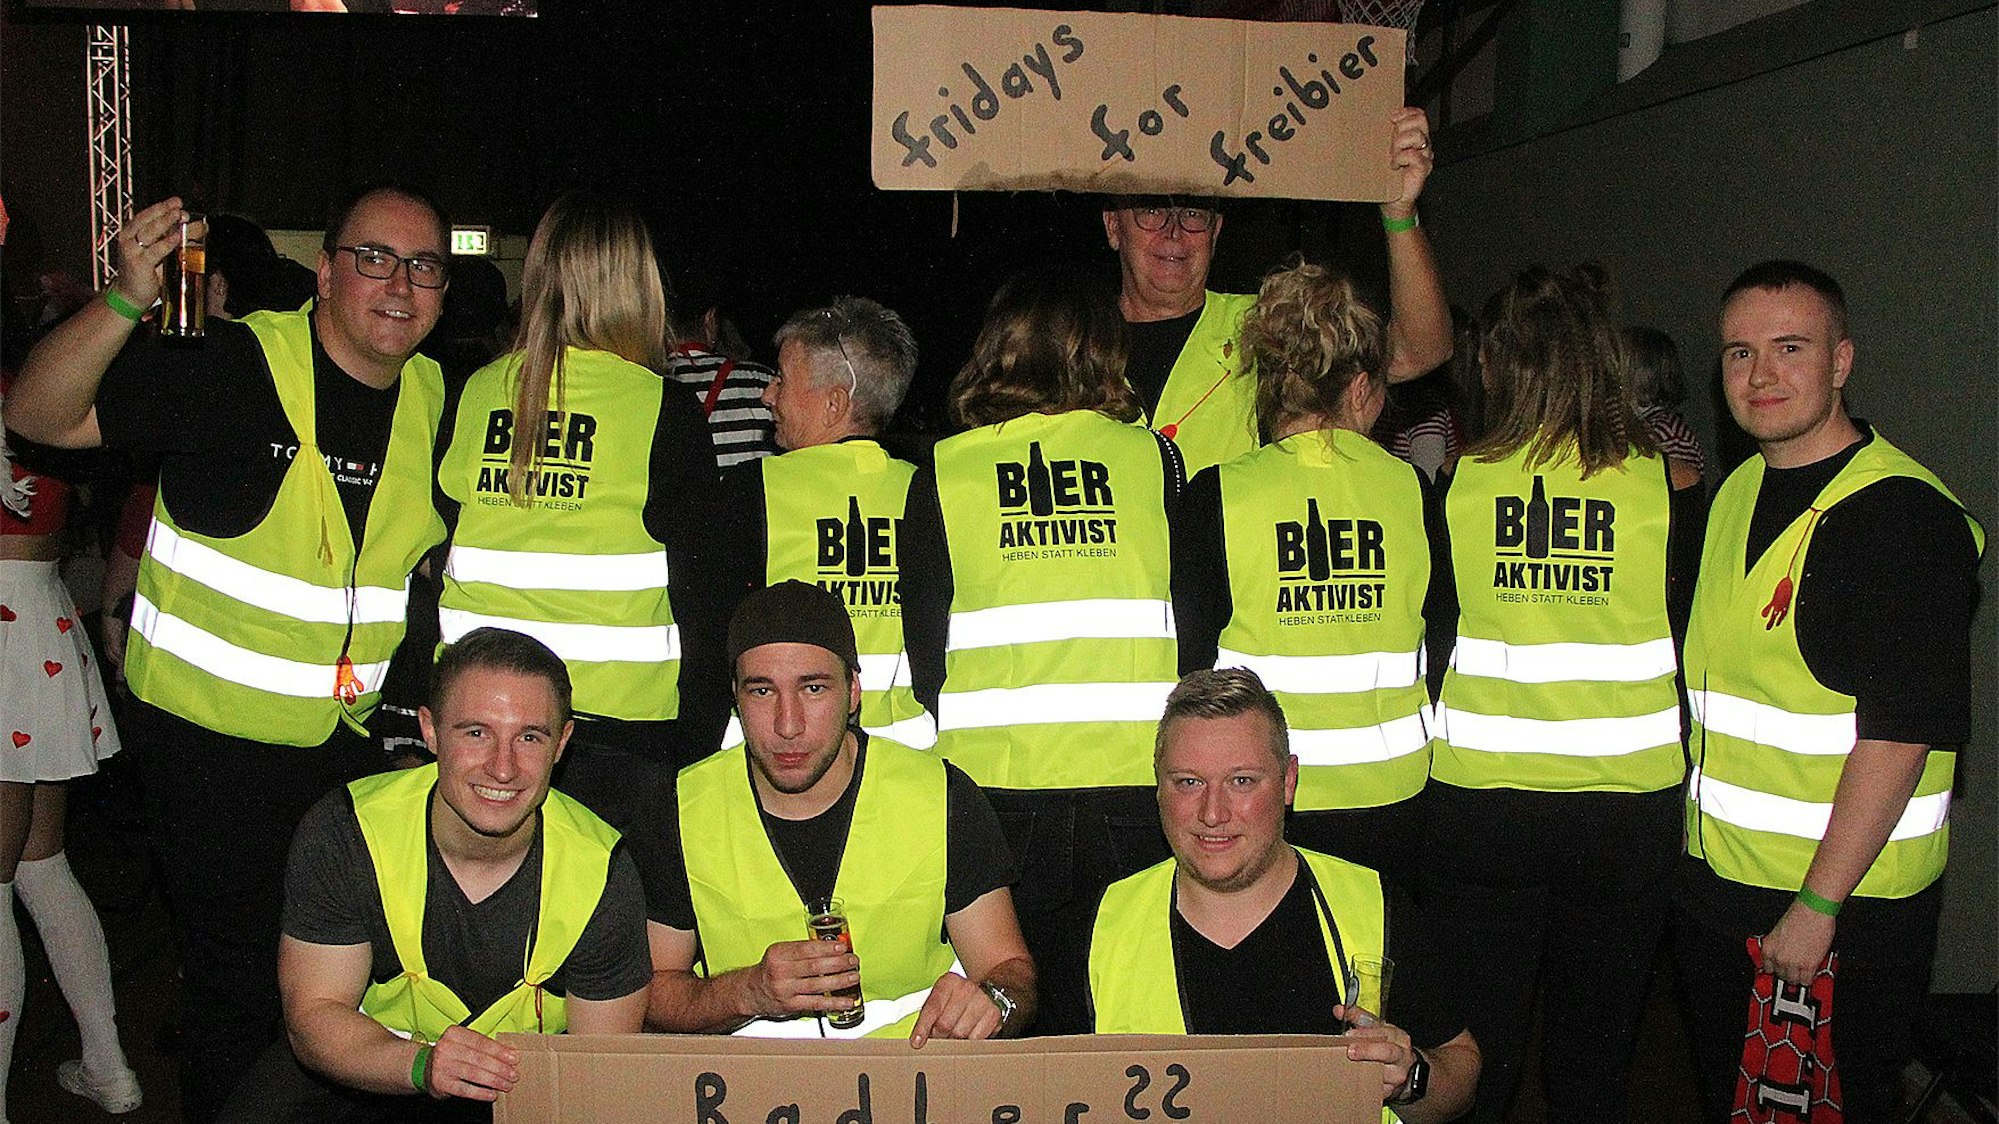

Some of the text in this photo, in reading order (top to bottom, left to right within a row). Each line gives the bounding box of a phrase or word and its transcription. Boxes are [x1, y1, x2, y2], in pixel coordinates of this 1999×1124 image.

[891, 24, 1380, 186] fridays for freibier
[483, 408, 597, 462] BER
[476, 467, 590, 499] AKIVIST
[996, 441, 1114, 517] BIER
[477, 496, 512, 507] HEBEN
[1494, 475, 1616, 559] BIER
[816, 496, 900, 577] BIE
[999, 519, 1117, 548] AKTIVIST
[1275, 498, 1386, 582] BIER
[1002, 548, 1117, 562] HEBEN STATT KLEBEN
[1493, 562, 1614, 592] AKTIVIST
[1276, 584, 1385, 612] AKTIVIST
[1495, 593, 1609, 606] HEBEN STATT KLEBEN
[850, 609, 879, 619] STATT
[1279, 616, 1315, 627] HEBEN
[1345, 613, 1381, 623] KLEBEN
